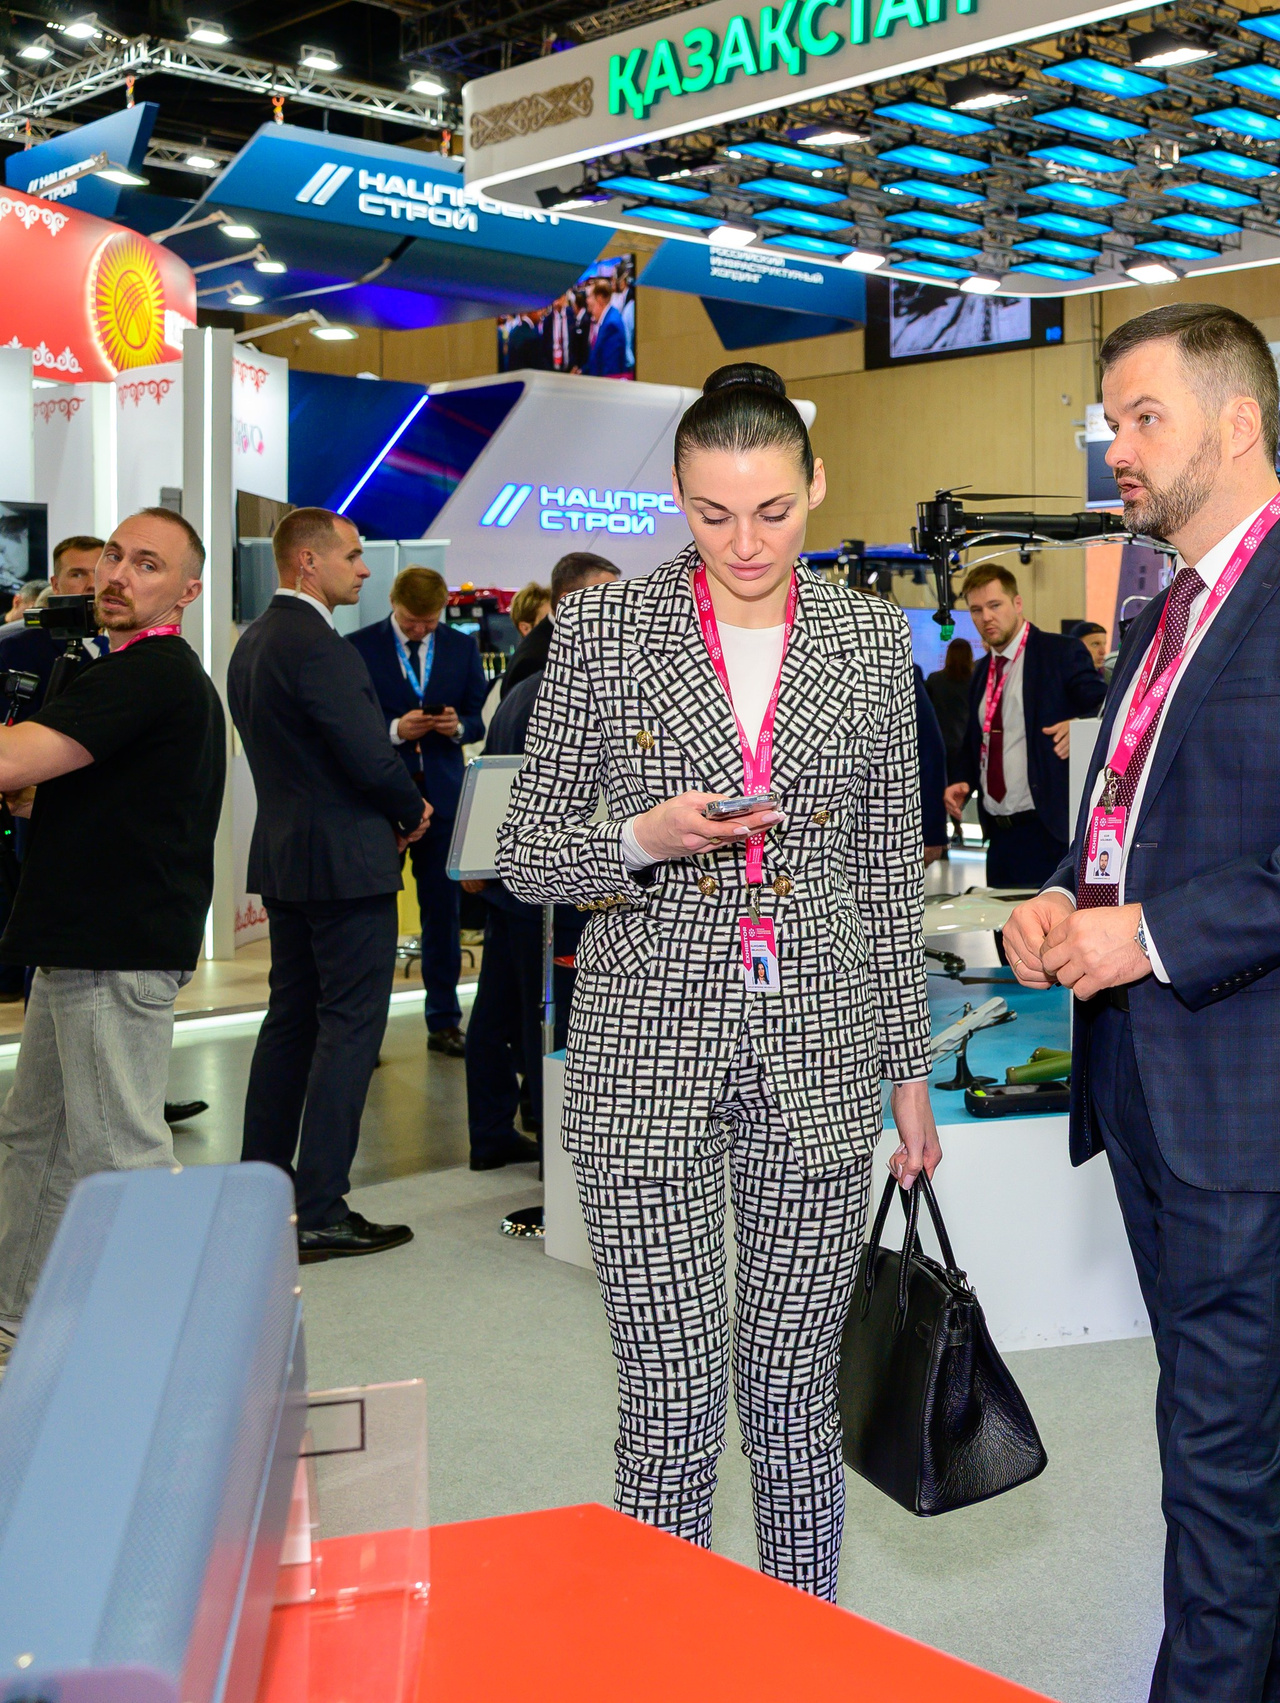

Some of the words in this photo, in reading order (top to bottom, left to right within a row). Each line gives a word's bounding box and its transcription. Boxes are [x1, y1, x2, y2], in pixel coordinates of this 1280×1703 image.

[359, 193, 479, 233] СТРОЙ
[539, 485, 684, 513] НАЦПРО
[539, 510, 655, 535] СТРОЙ
[1091, 816, 1100, 855] EXHIBITOR
[742, 926, 751, 964] EXHIBITOR
